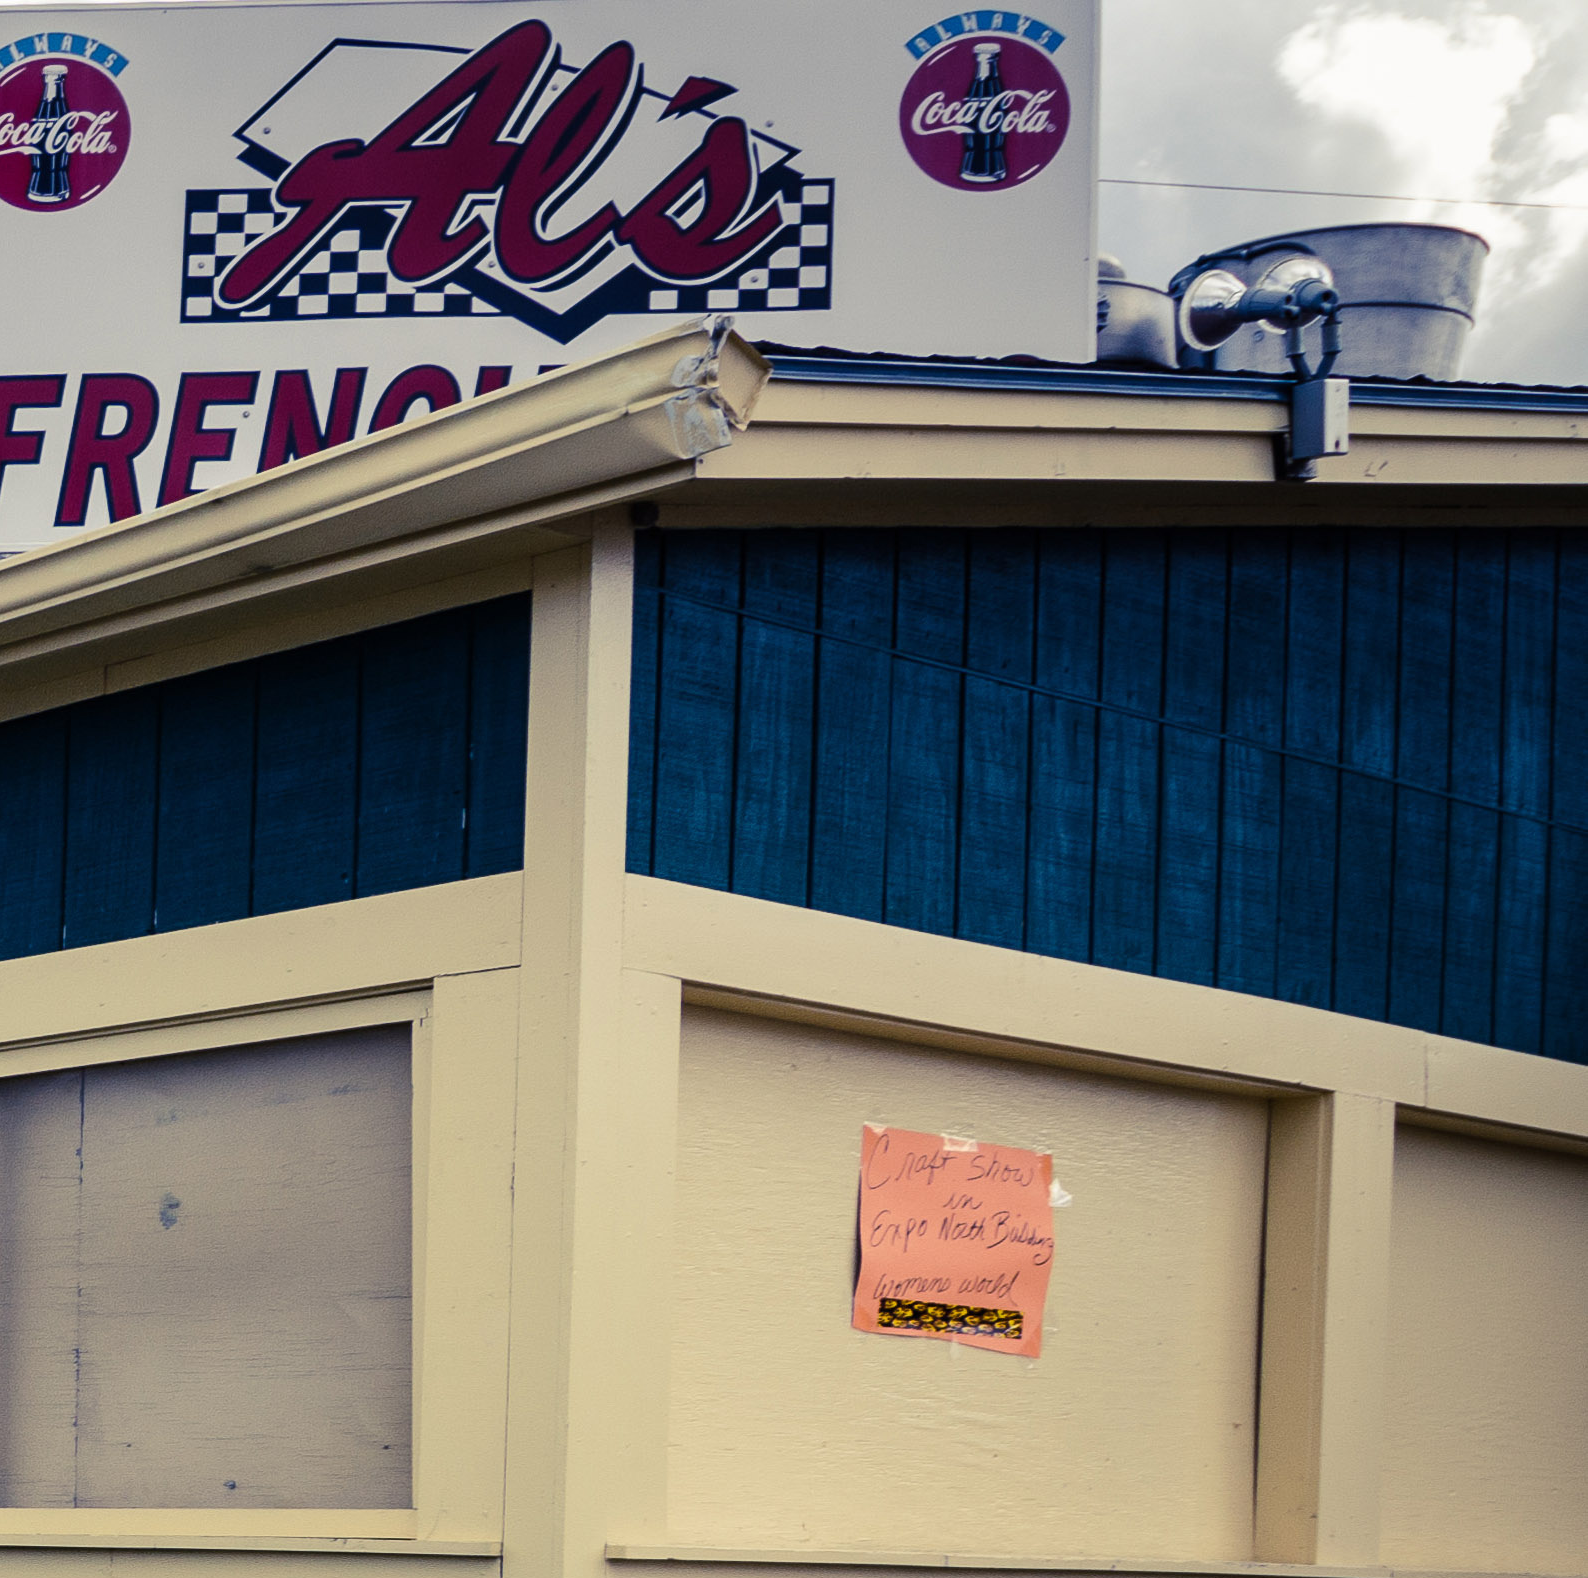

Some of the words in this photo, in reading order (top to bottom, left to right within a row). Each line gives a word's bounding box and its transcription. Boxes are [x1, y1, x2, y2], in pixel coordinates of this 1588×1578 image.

[913, 12, 1054, 52] ALWAYS
[911, 89, 1058, 136] Coca-Cola
[215, 18, 785, 308] Al's
[866, 1133, 957, 1190] Craft
[942, 1193, 983, 1211] in
[869, 1209, 927, 1254] Expo
[938, 1213, 987, 1242] North
[986, 1210, 1055, 1266] Building
